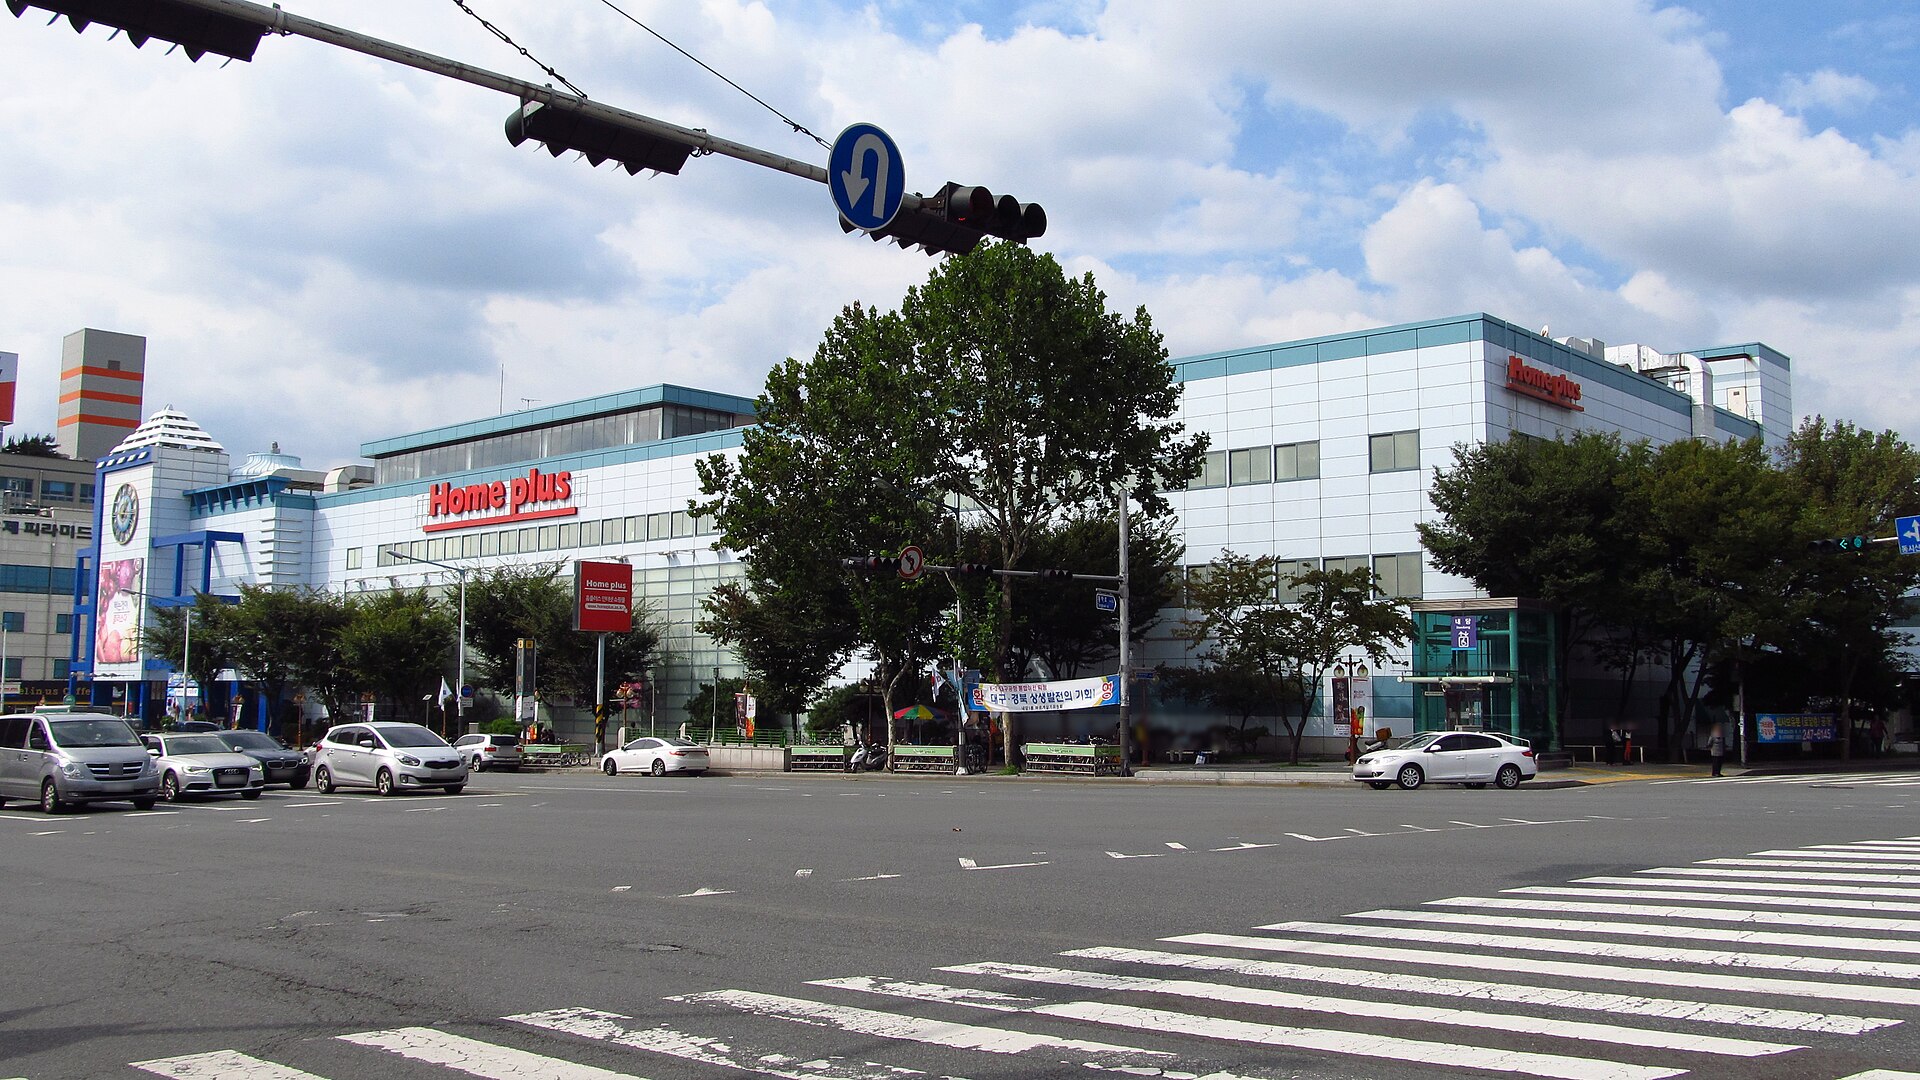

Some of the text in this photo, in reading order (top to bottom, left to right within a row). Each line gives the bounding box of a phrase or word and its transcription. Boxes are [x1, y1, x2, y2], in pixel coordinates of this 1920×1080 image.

[1508, 355, 1582, 401] Home plus
[429, 467, 571, 516] Home plus
[24, 522, 92, 540] 피라미드
[586, 580, 626, 590] Home plus
[973, 689, 984, 705] 환
[1029, 690, 1073, 704] 상생발전의
[1102, 682, 1113, 699] 영
